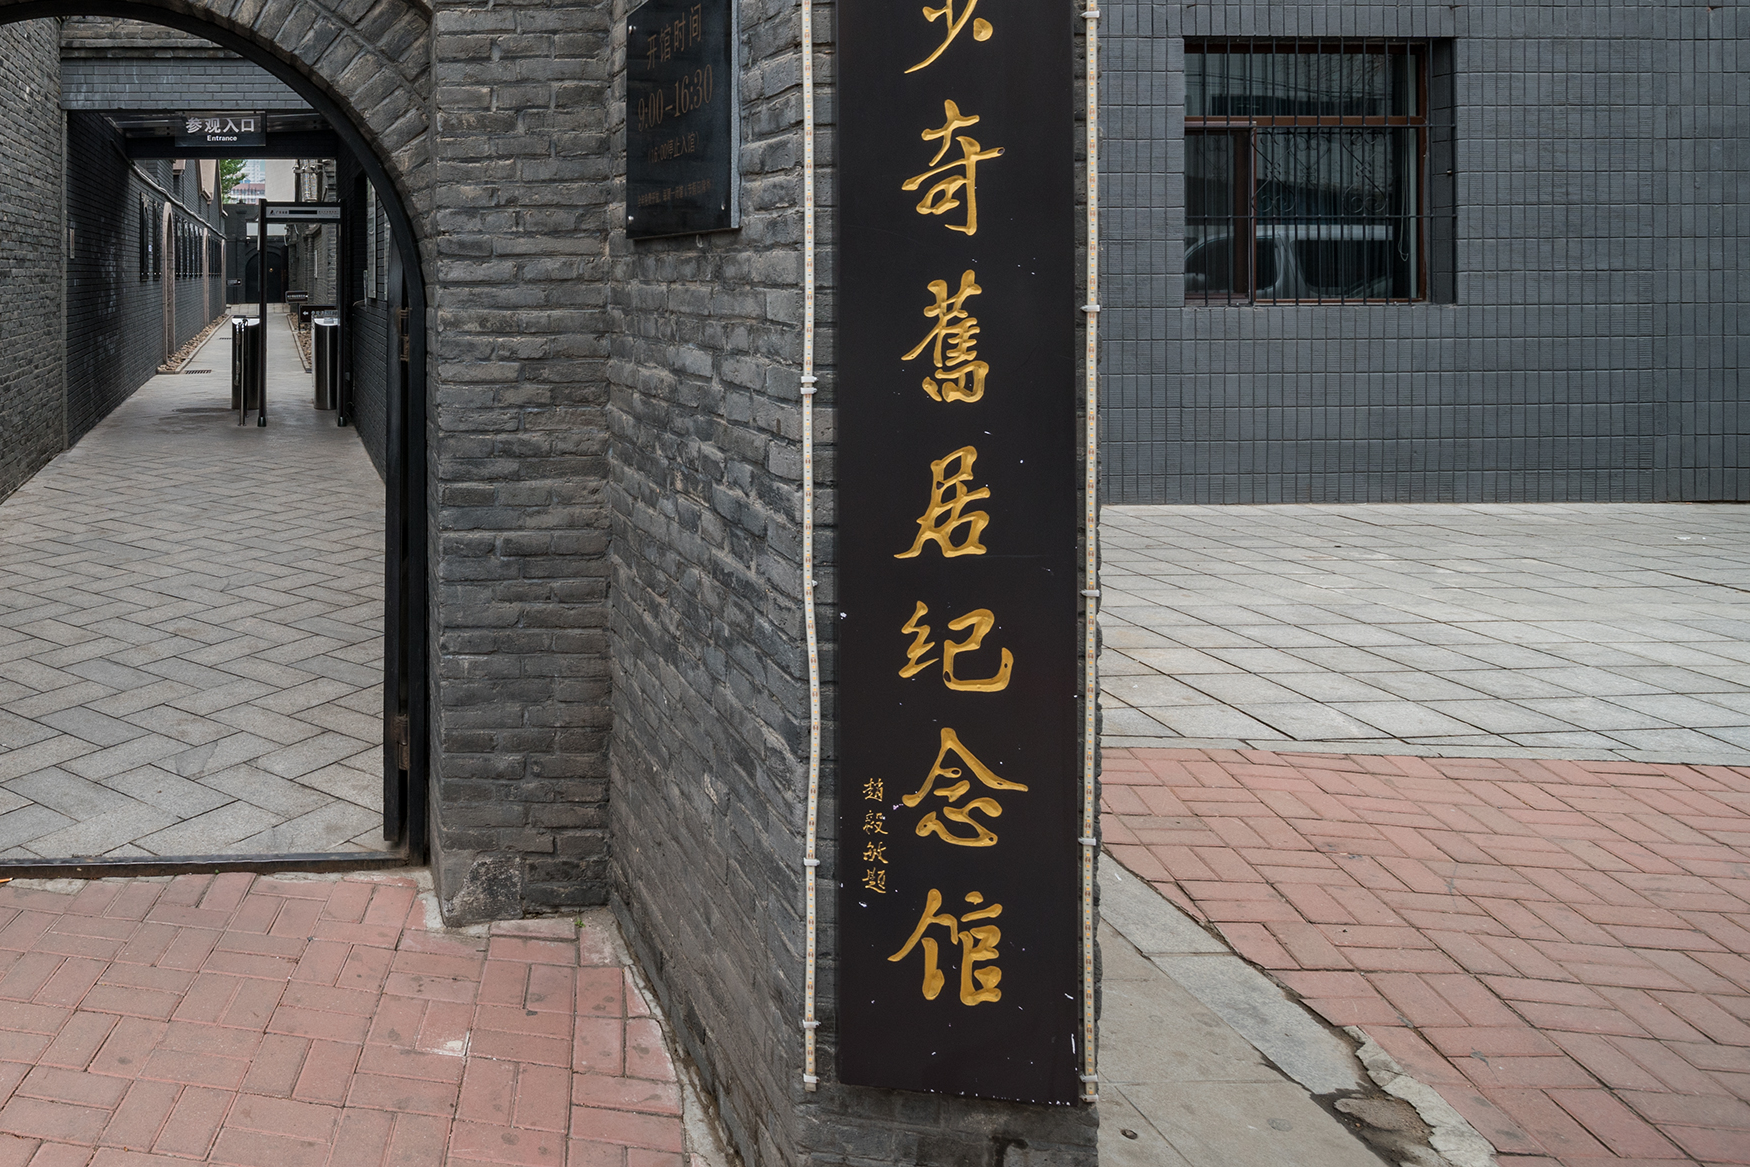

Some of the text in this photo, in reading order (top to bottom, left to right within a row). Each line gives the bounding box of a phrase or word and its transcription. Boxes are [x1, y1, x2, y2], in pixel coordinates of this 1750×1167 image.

[646, 3, 701, 70] 开馆时间
[185, 117, 255, 133] 参观入口
[206, 134, 238, 142] Entrance
